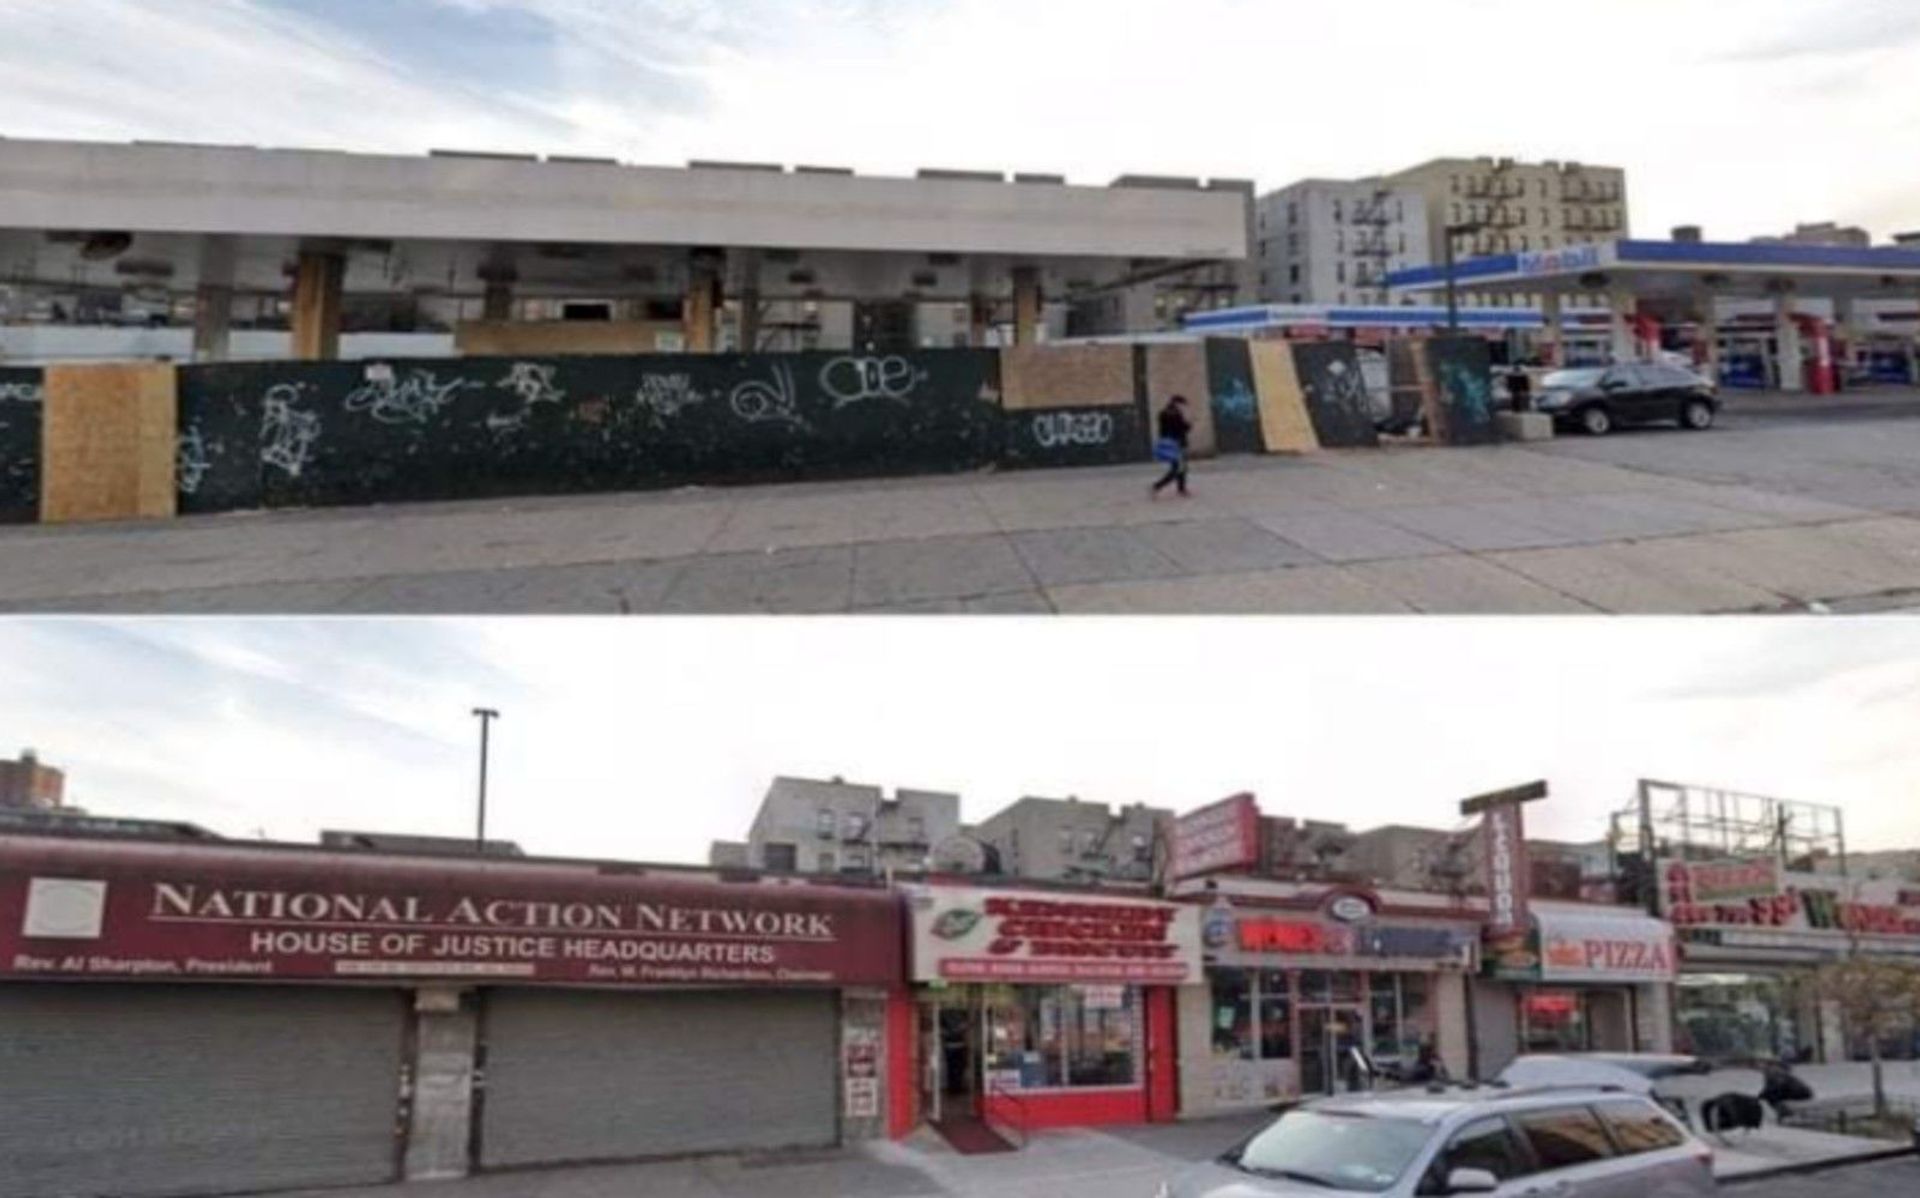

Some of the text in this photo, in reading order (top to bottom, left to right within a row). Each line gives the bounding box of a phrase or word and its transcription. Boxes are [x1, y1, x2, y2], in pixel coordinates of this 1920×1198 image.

[1520, 247, 1598, 273] Mobil
[153, 882, 832, 936] NATIONAL ACTION NETWORK
[250, 931, 776, 965] HOUSE OF JUSTICE HEADQUARTERS
[1583, 938, 1670, 970] PIZZA
[186, 959, 273, 974] President
